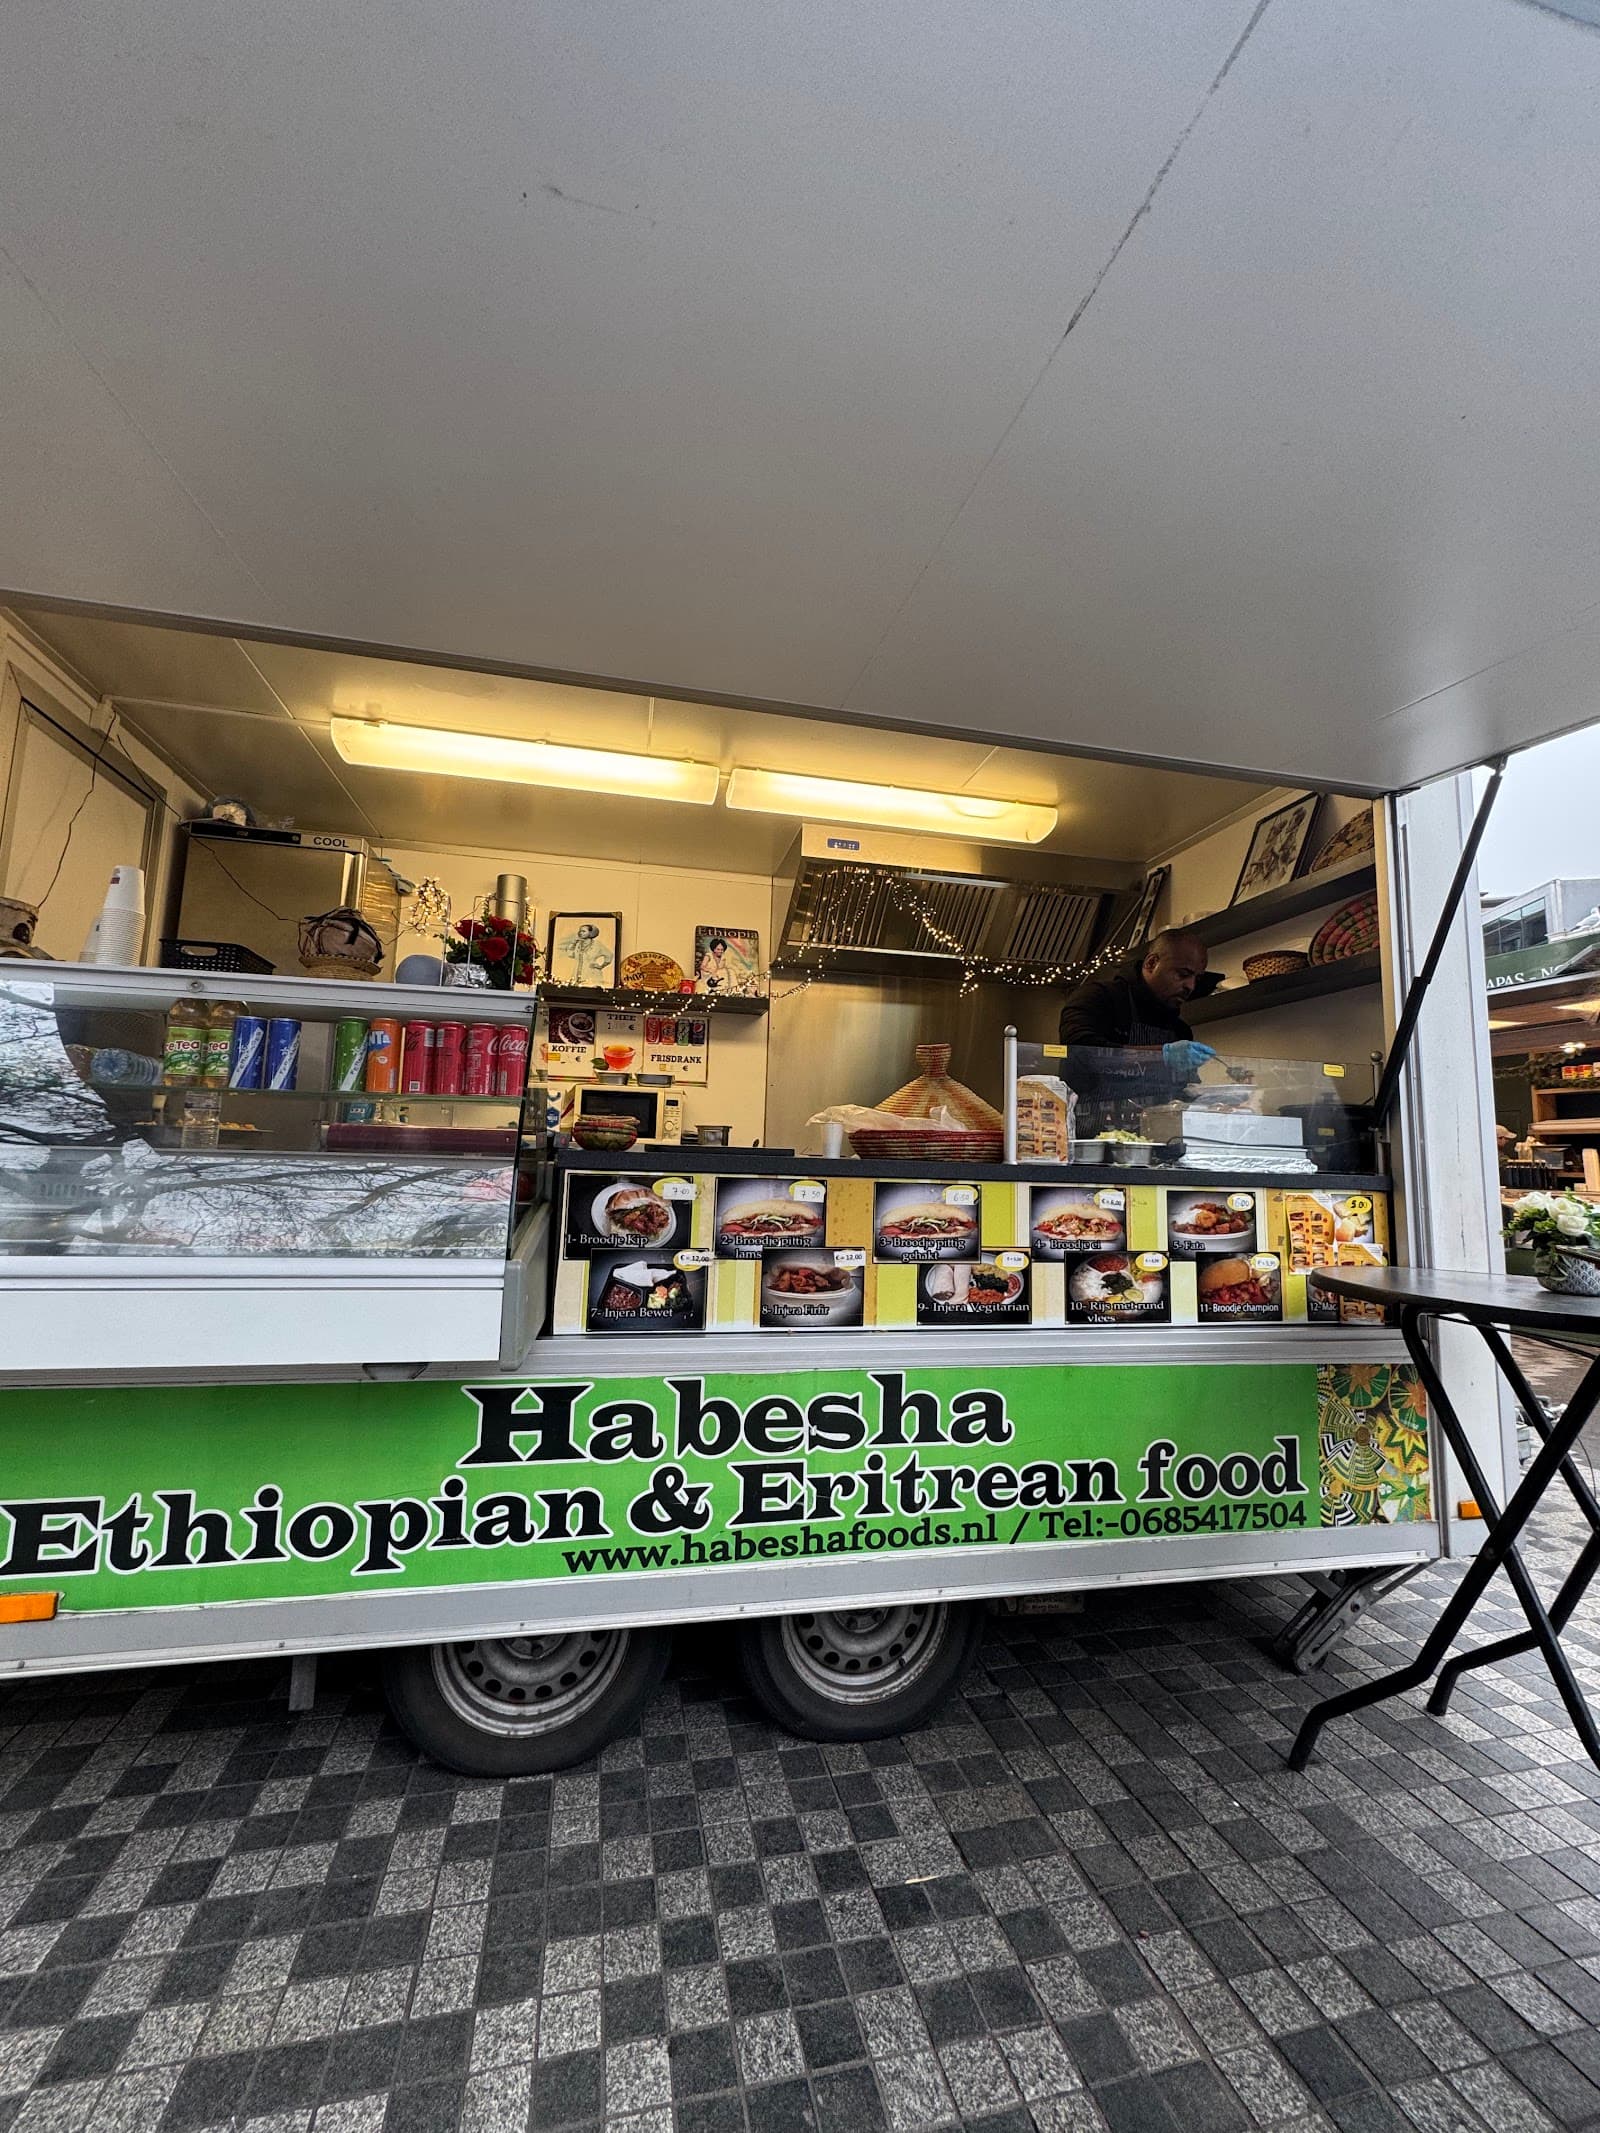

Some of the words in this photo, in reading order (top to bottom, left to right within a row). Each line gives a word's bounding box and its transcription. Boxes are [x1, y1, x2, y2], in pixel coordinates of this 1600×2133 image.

[313, 836, 349, 848] COOL
[698, 926, 759, 940] Ethiopia
[607, 1013, 637, 1022] THEE
[175, 1039, 200, 1052] Tea
[551, 1045, 587, 1053] KOFFIE
[650, 1054, 702, 1064] FRISDRANK
[567, 1235, 577, 1244] 1-
[580, 1234, 624, 1247] Broodje
[627, 1235, 648, 1247] Kip
[721, 1235, 733, 1245] 2-
[735, 1235, 780, 1247] Broodje
[781, 1236, 811, 1247] pittig
[879, 1238, 890, 1247] 3-
[893, 1237, 935, 1250] Broodje
[936, 1238, 966, 1250] pittig
[1034, 1240, 1047, 1249] 4-
[1050, 1240, 1089, 1252] Broodje
[1091, 1241, 1102, 1250] ei
[1172, 1241, 1183, 1250] 5-
[1184, 1241, 1206, 1250] Fata
[902, 1250, 939, 1262] gehakt
[761, 1306, 772, 1315] 8-
[774, 1305, 801, 1318] Injera
[917, 1302, 929, 1312] 9-
[933, 1302, 968, 1314] Injera
[970, 1302, 1030, 1314] Vegitarian
[1070, 1302, 1087, 1311] 10-
[1090, 1301, 1111, 1312] Rijs
[1114, 1302, 1134, 1310] met
[1136, 1301, 1164, 1310] rund
[1199, 1303, 1212, 1312] 11-
[1212, 1303, 1242, 1315] Broodje
[1242, 1303, 1279, 1315] champion
[1309, 1303, 1321, 1311] 12-
[591, 1307, 601, 1318] 7-
[604, 1308, 636, 1320] Injera
[640, 1307, 673, 1318] Bewet
[1087, 1314, 1116, 1323] vlees
[458, 1371, 1012, 1465] Habesha
[0, 1477, 611, 1578] Ethiopian
[628, 1464, 714, 1536] &
[727, 1453, 1127, 1532] Eritrean
[1137, 1435, 1309, 1504] food
[563, 1511, 998, 1574] www.habeshafoods.nl
[1009, 1511, 1031, 1545] /
[1039, 1502, 1308, 1542] Tel:-0685417504
